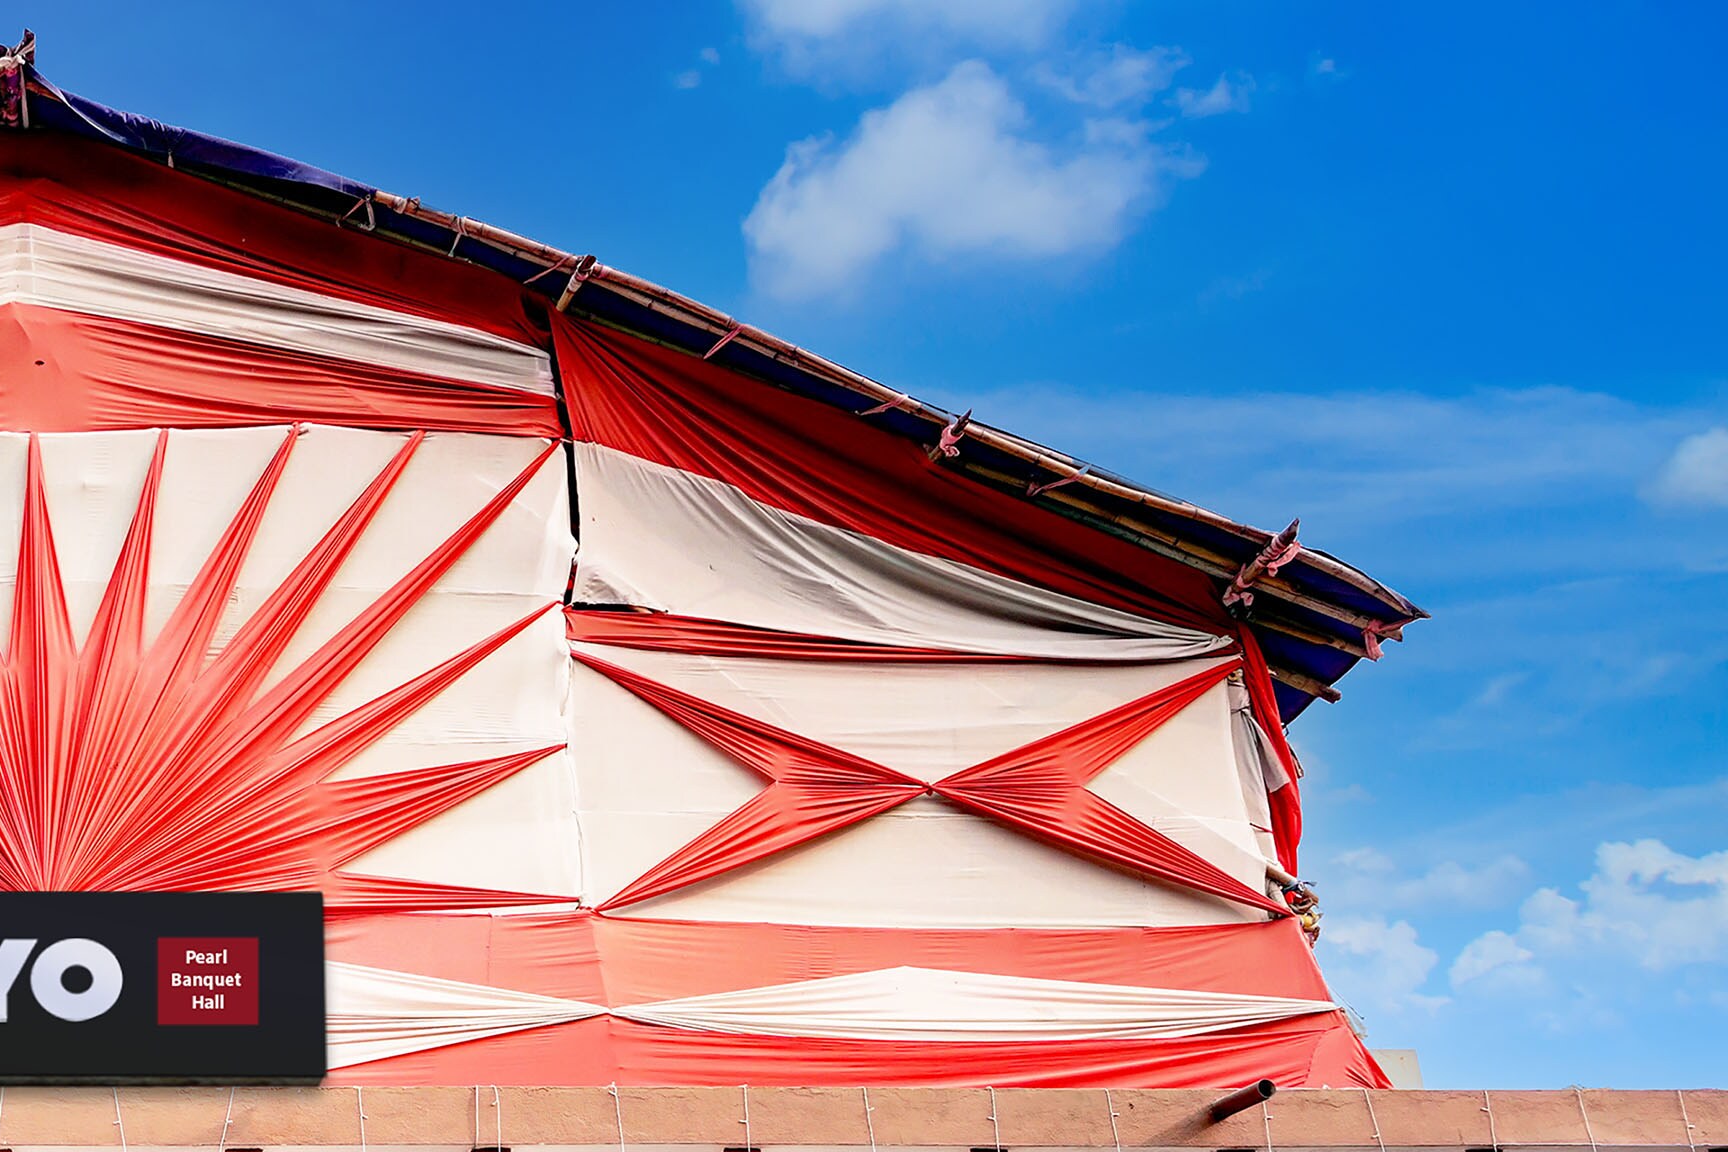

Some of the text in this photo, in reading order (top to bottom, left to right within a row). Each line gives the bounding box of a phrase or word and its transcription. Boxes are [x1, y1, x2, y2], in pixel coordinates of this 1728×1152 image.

[185, 949, 228, 965] Pearl
[171, 972, 242, 992] Banquet
[192, 995, 225, 1010] Hall
